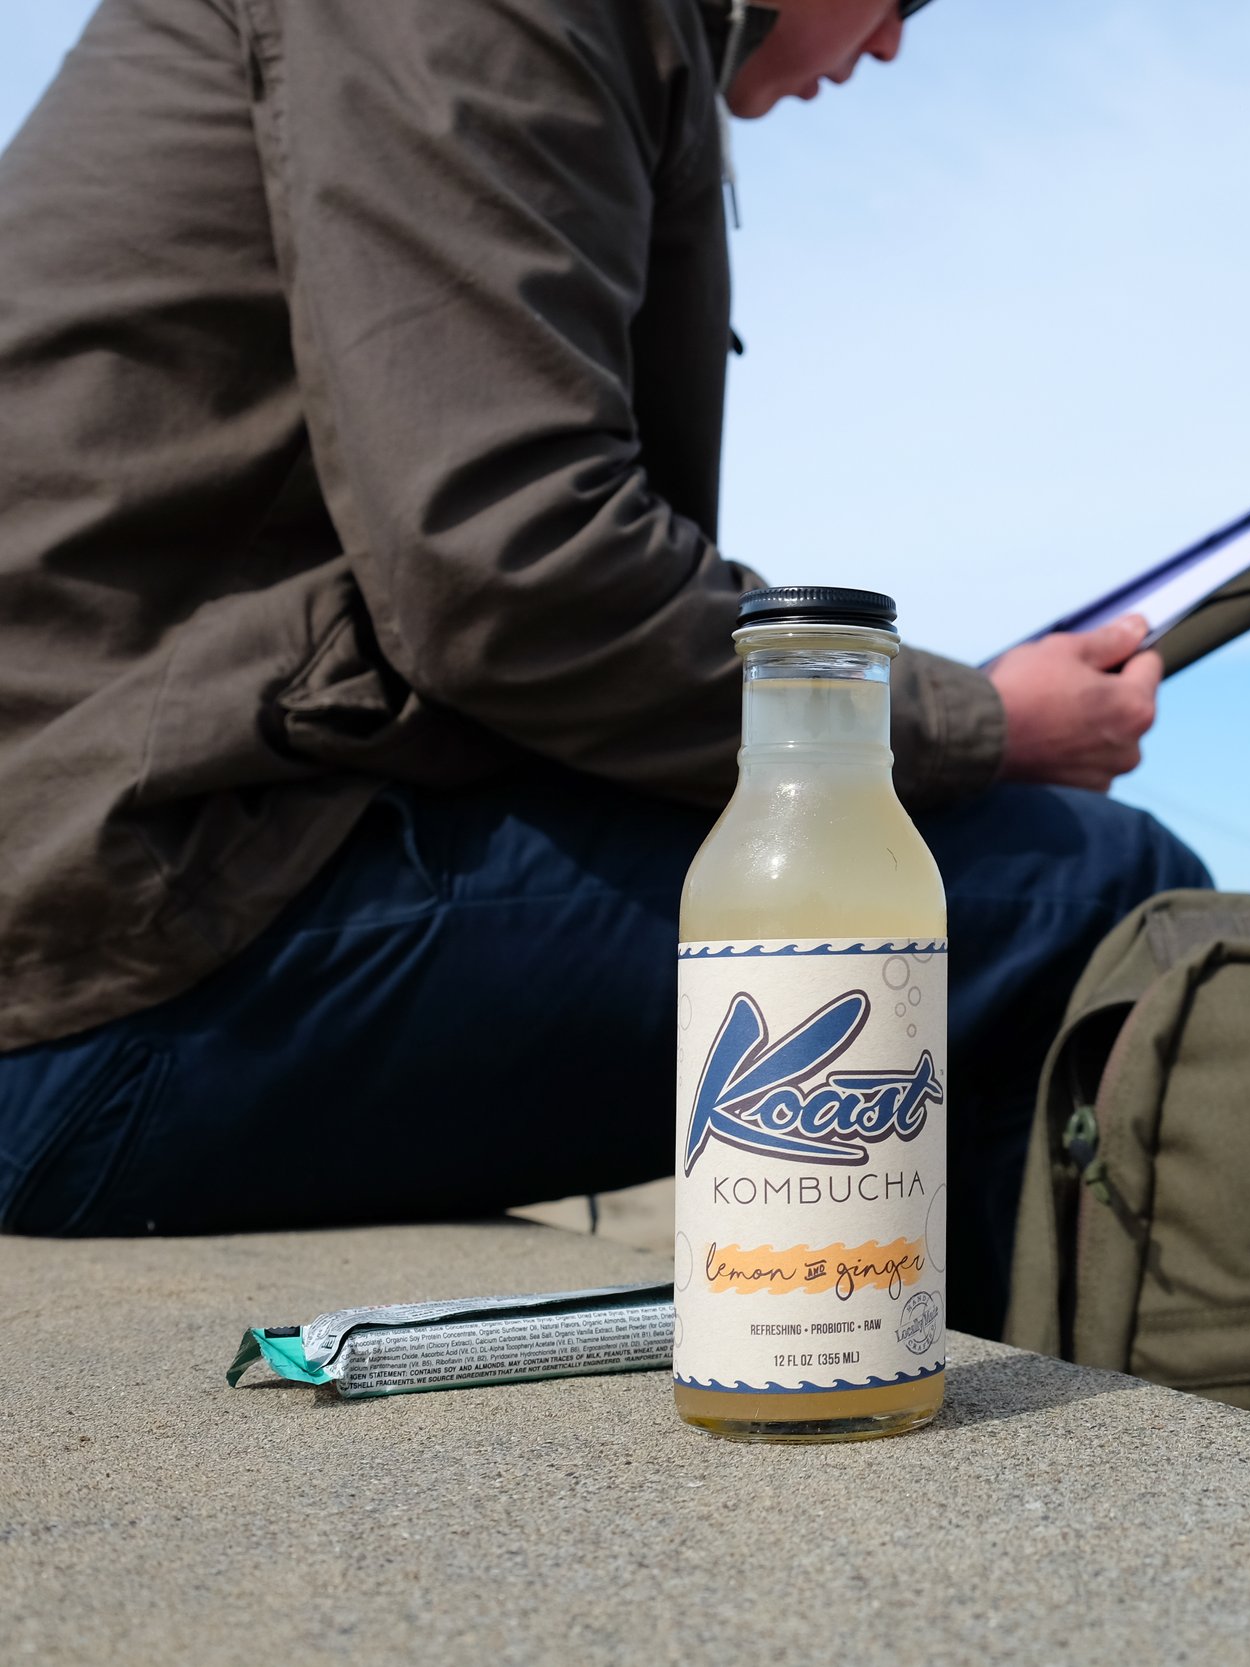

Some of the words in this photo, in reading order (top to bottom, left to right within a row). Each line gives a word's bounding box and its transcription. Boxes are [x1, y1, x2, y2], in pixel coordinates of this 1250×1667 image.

[684, 989, 943, 1178] Koast
[713, 1170, 925, 1205] KOMBUCHA
[705, 1242, 797, 1281] lemon
[805, 1263, 826, 1279] AND
[835, 1251, 926, 1301] ginger
[386, 1336, 408, 1344] Organic
[409, 1334, 420, 1342] Soy
[479, 1328, 500, 1336] Organic
[502, 1325, 528, 1333] Sunflower
[541, 1322, 559, 1330] Natural
[582, 1318, 602, 1326] Organic
[555, 1330, 575, 1338] Organic
[750, 1323, 802, 1336] REFRESHING
[810, 1321, 855, 1335] PROBIOTIC
[864, 1318, 882, 1331] RAW
[446, 1348, 458, 1356] Acid
[535, 1340, 555, 1348] Acetate
[774, 1355, 785, 1367] 12
[787, 1355, 799, 1367] FL
[800, 1354, 813, 1366] OZ
[818, 1353, 839, 1366] (355
[842, 1351, 860, 1364] ML)
[369, 1371, 408, 1379] STATEMENT:
[410, 1368, 441, 1376] CONTAINS
[523, 1357, 549, 1365] CONTAIN
[551, 1354, 574, 1362] TRACES
[656, 1344, 668, 1352] AND
[428, 1374, 454, 1382] SOURCE
[456, 1370, 497, 1380] INGREDIENTS
[514, 1366, 527, 1374] ARE
[542, 1361, 581, 1371] GENETICALLY
